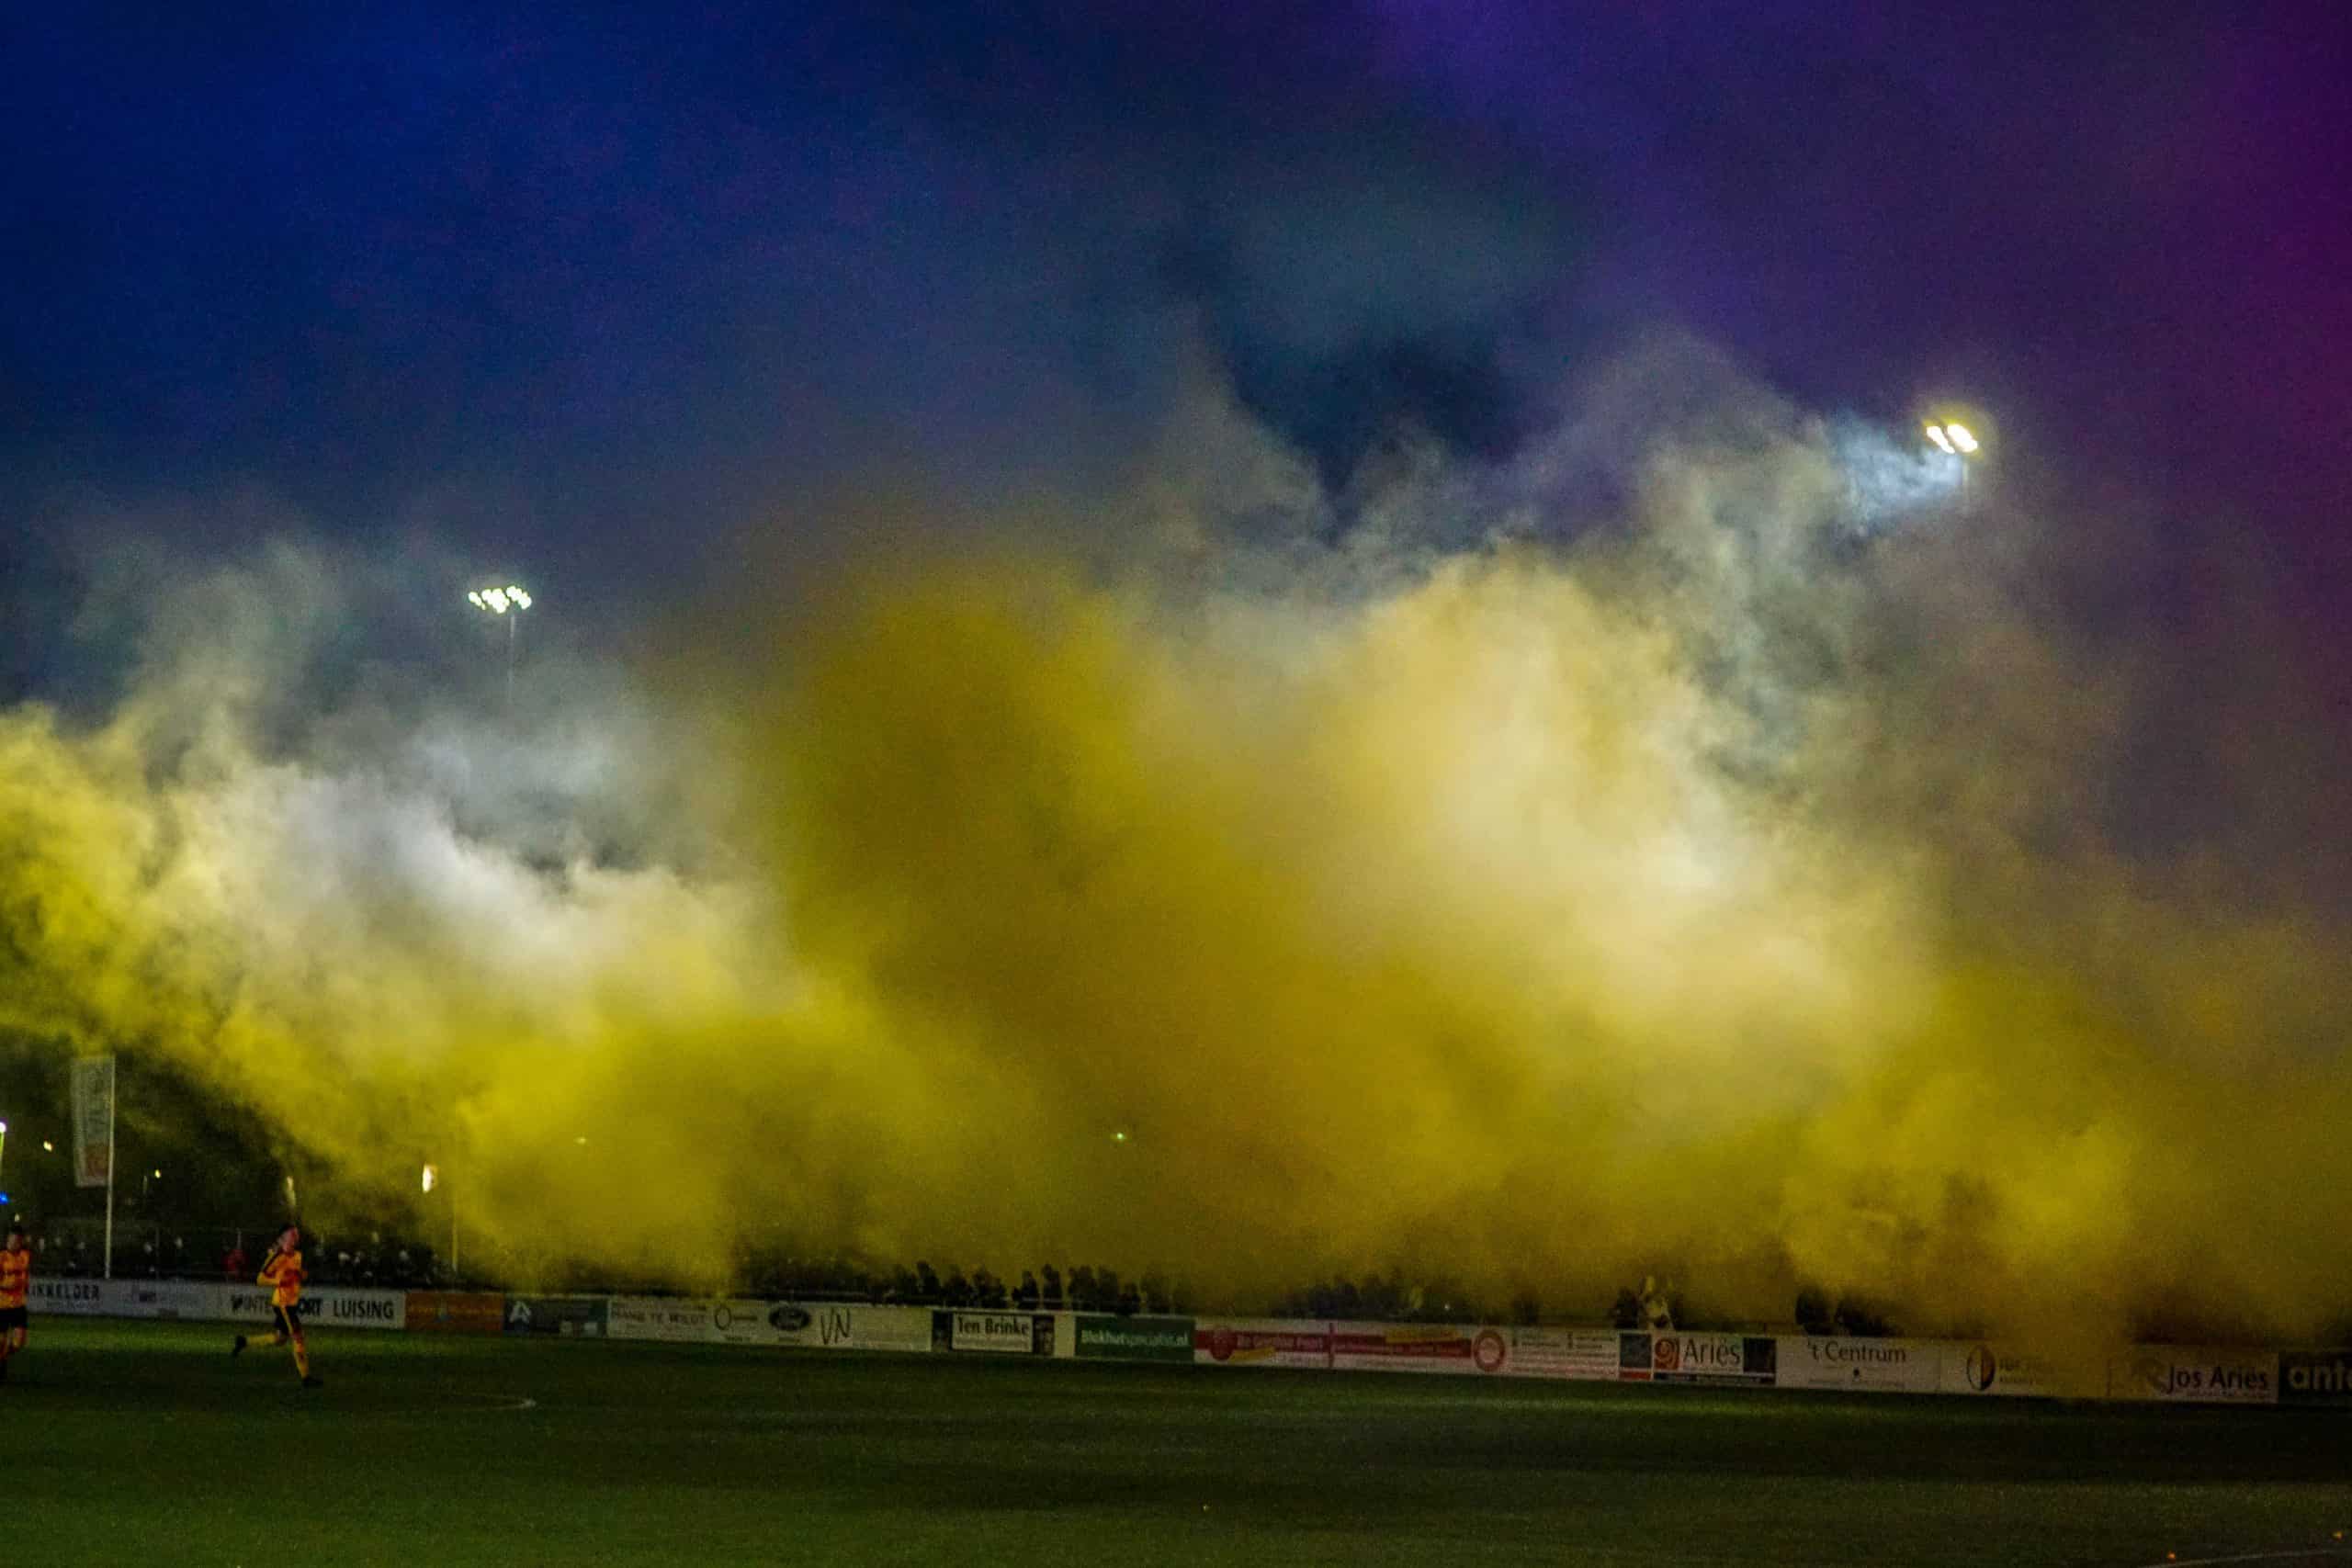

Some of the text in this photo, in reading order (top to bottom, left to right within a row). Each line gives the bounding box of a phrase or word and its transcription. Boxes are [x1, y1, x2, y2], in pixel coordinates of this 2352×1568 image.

[334, 1298, 394, 1319] LUISING
[957, 1314, 1030, 1335] Ten Brinke
[1825, 1341, 1907, 1362] Centrum
[2166, 1364, 2201, 1393] Jos
